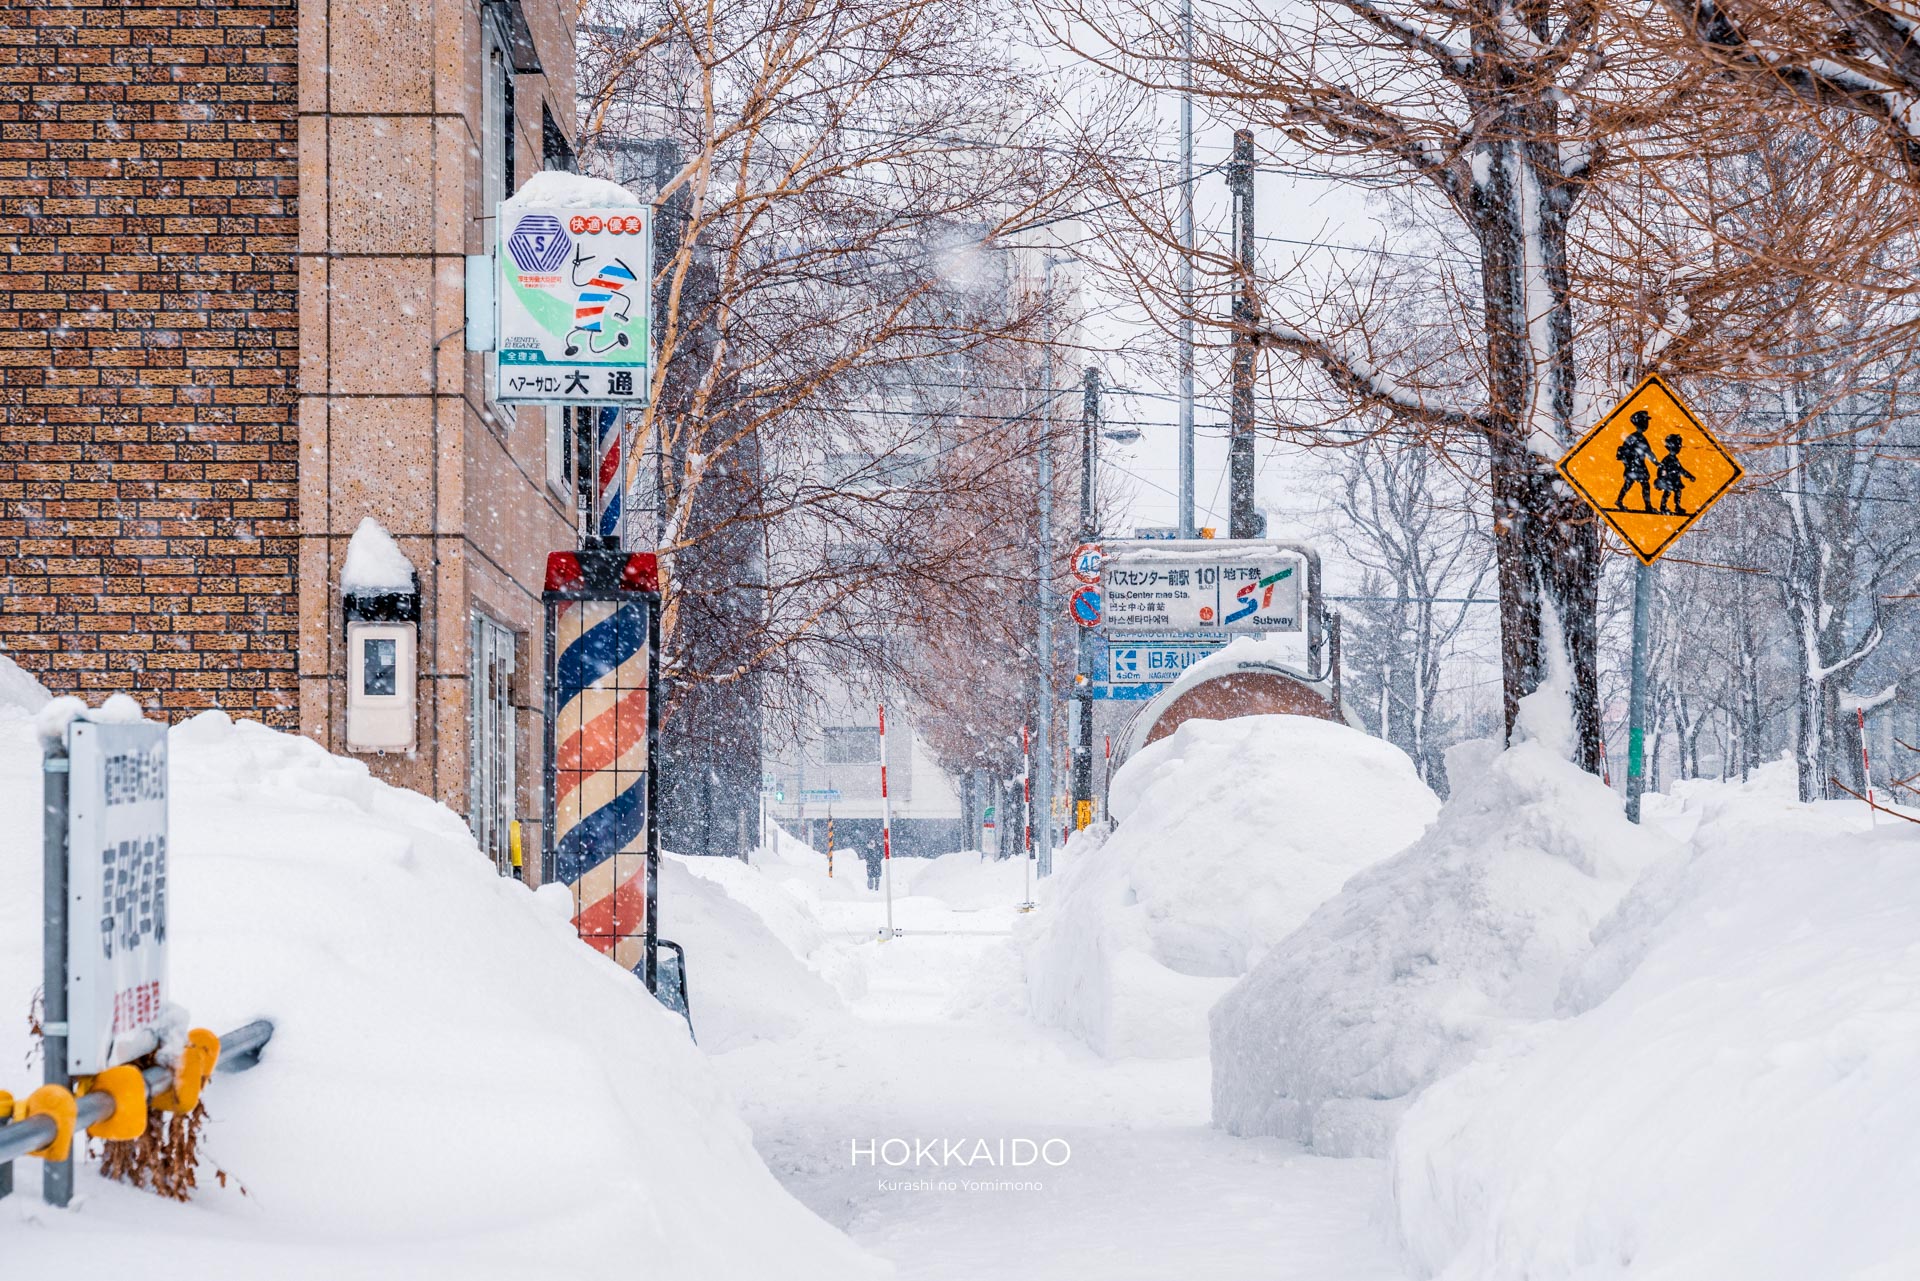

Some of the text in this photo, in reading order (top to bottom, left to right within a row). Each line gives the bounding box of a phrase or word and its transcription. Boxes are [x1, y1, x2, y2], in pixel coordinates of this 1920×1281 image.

[1108, 568, 1216, 586] バスセンター前駅 10
[1223, 567, 1262, 581] 地下鉄
[1109, 590, 1125, 599] Bus
[1127, 590, 1154, 599] Center
[1174, 590, 1190, 599] Sta.
[1252, 616, 1294, 627] Subway
